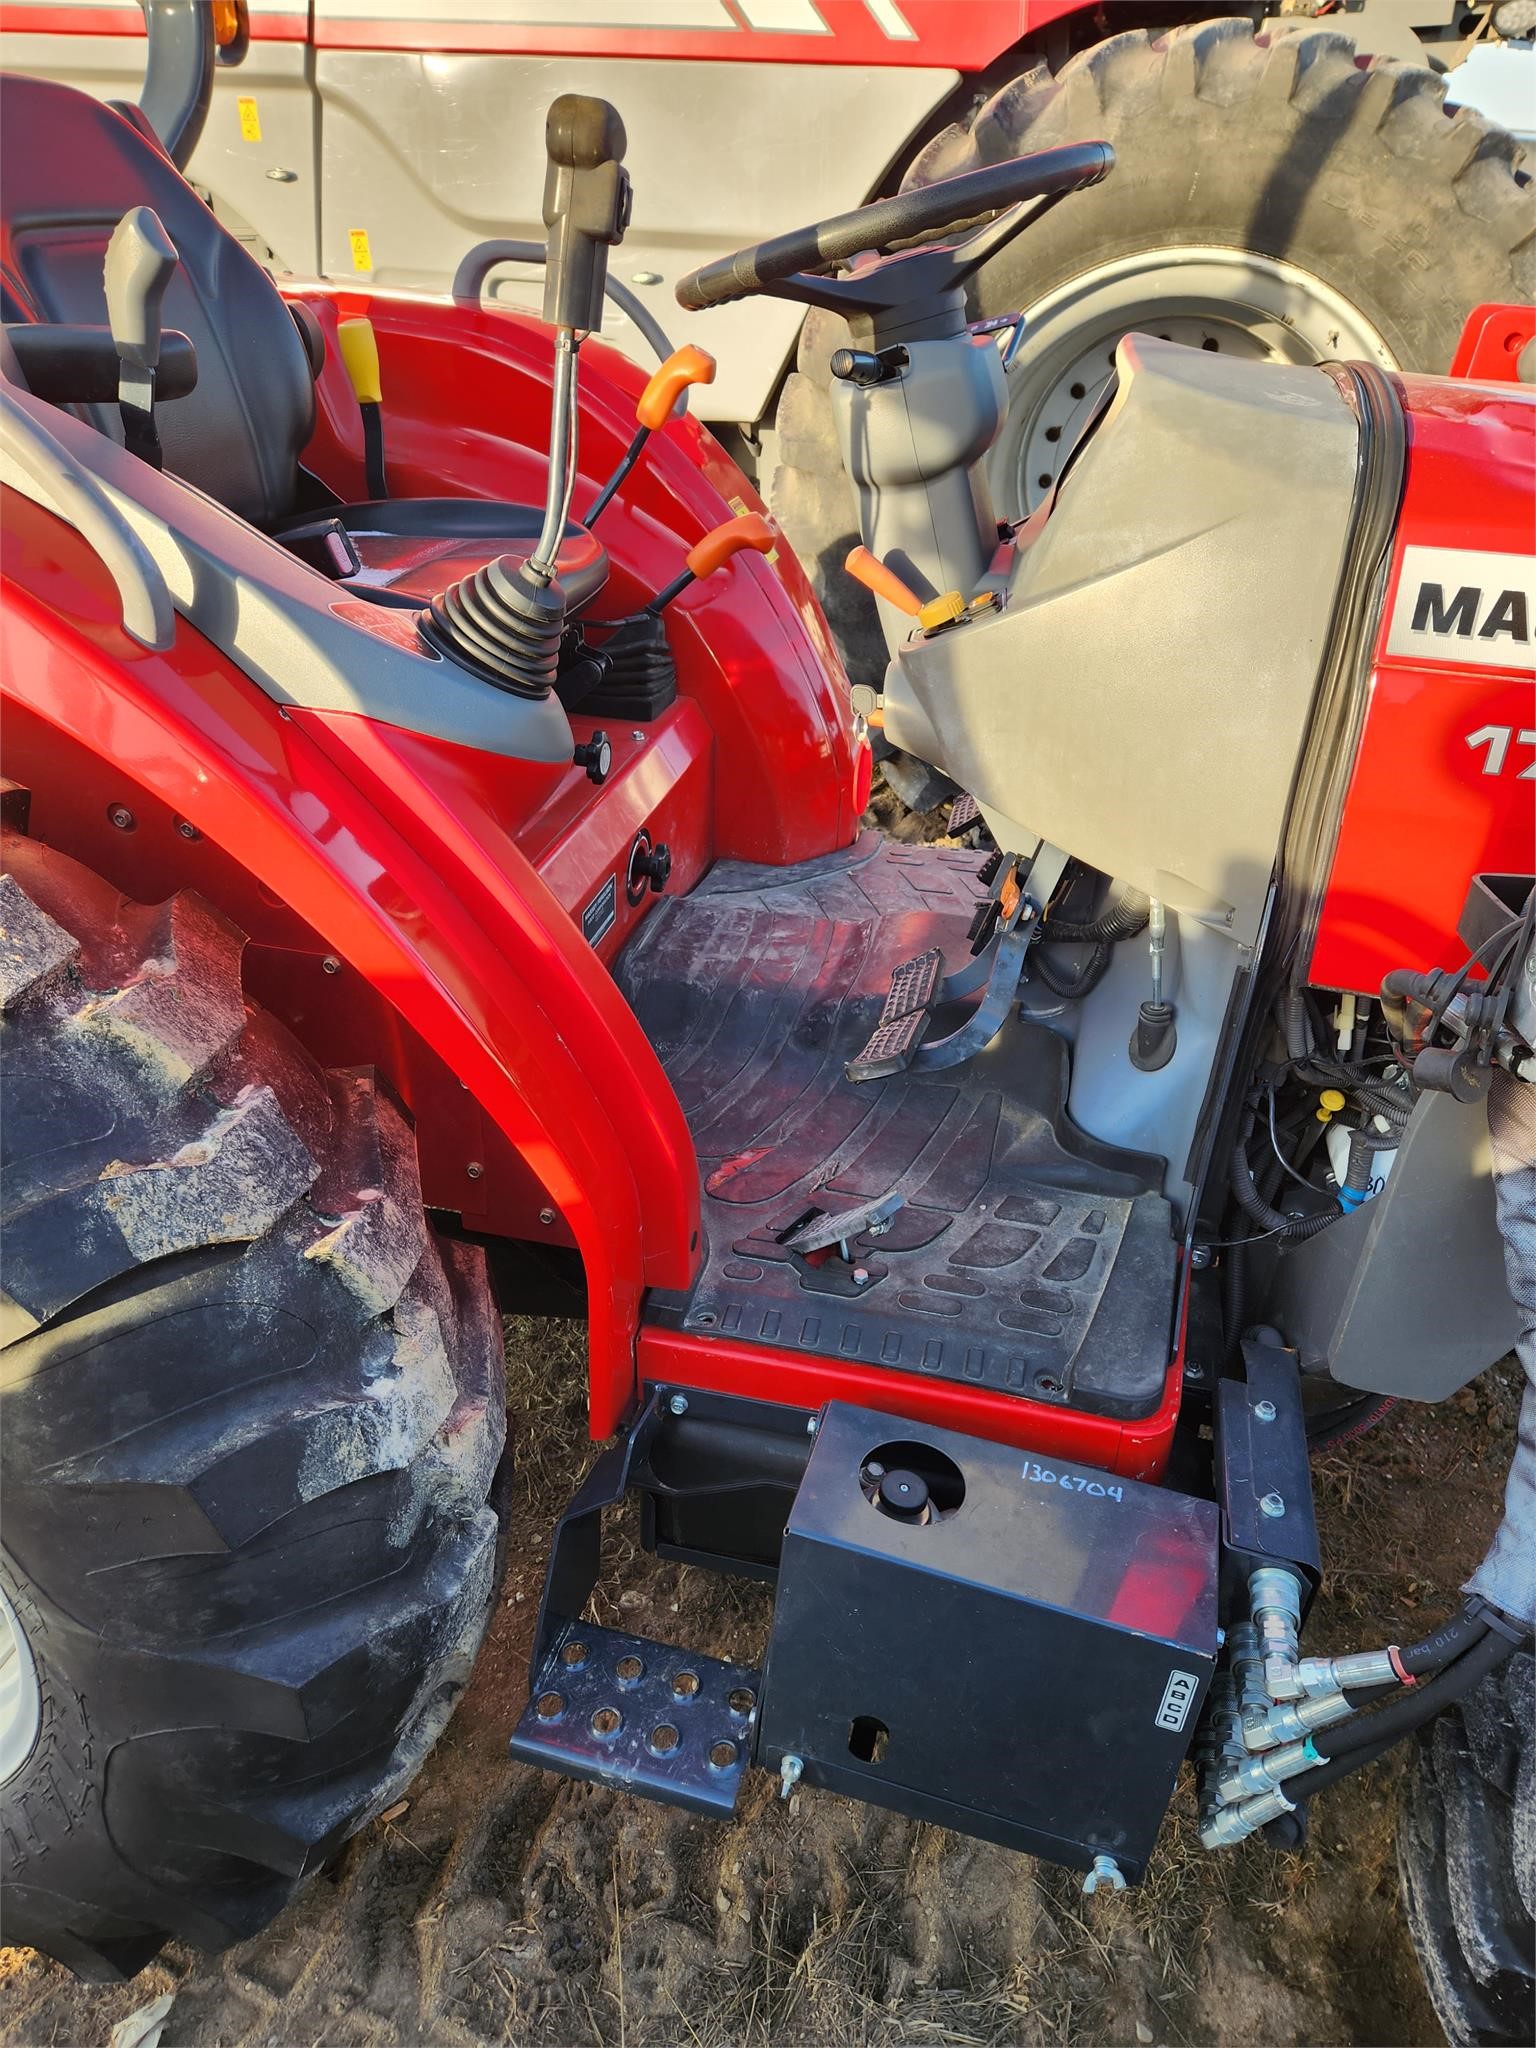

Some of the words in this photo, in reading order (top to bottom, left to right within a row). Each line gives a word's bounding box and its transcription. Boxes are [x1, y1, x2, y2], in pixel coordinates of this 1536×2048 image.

[1411, 582, 1536, 643] MA
[1021, 1461, 1123, 1502] 1306704
[1406, 1644, 1432, 1659] bar
[1434, 1626, 1458, 1648] 210
